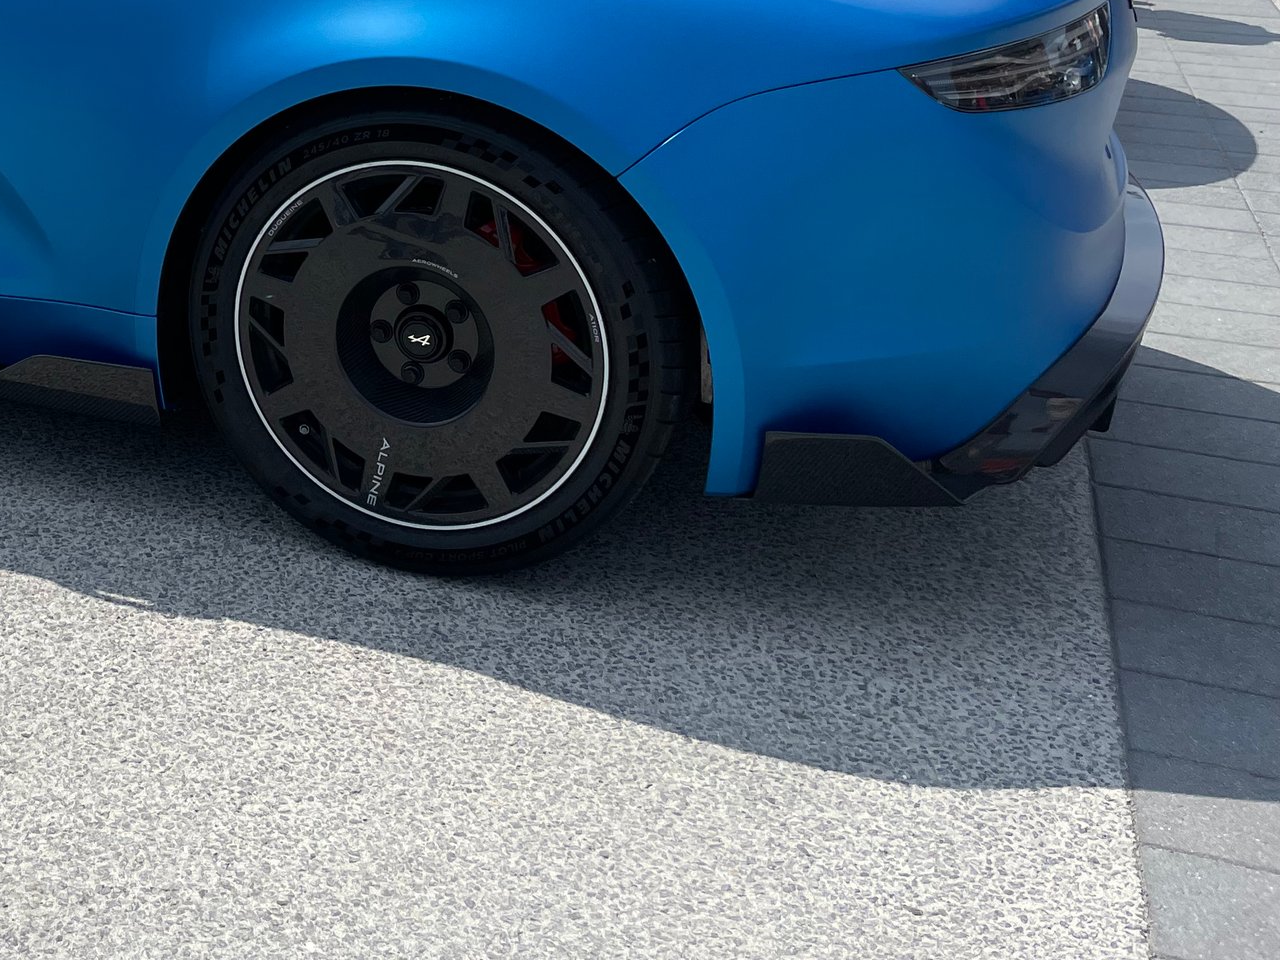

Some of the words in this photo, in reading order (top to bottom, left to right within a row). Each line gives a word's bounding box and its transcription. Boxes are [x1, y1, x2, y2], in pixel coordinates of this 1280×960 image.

[214, 156, 293, 261] MICHELIN
[267, 199, 304, 237] DUQUEINE
[411, 258, 459, 279] AEROWHEELS
[366, 437, 391, 507] ALPINE
[537, 441, 631, 542] MICHELIN
